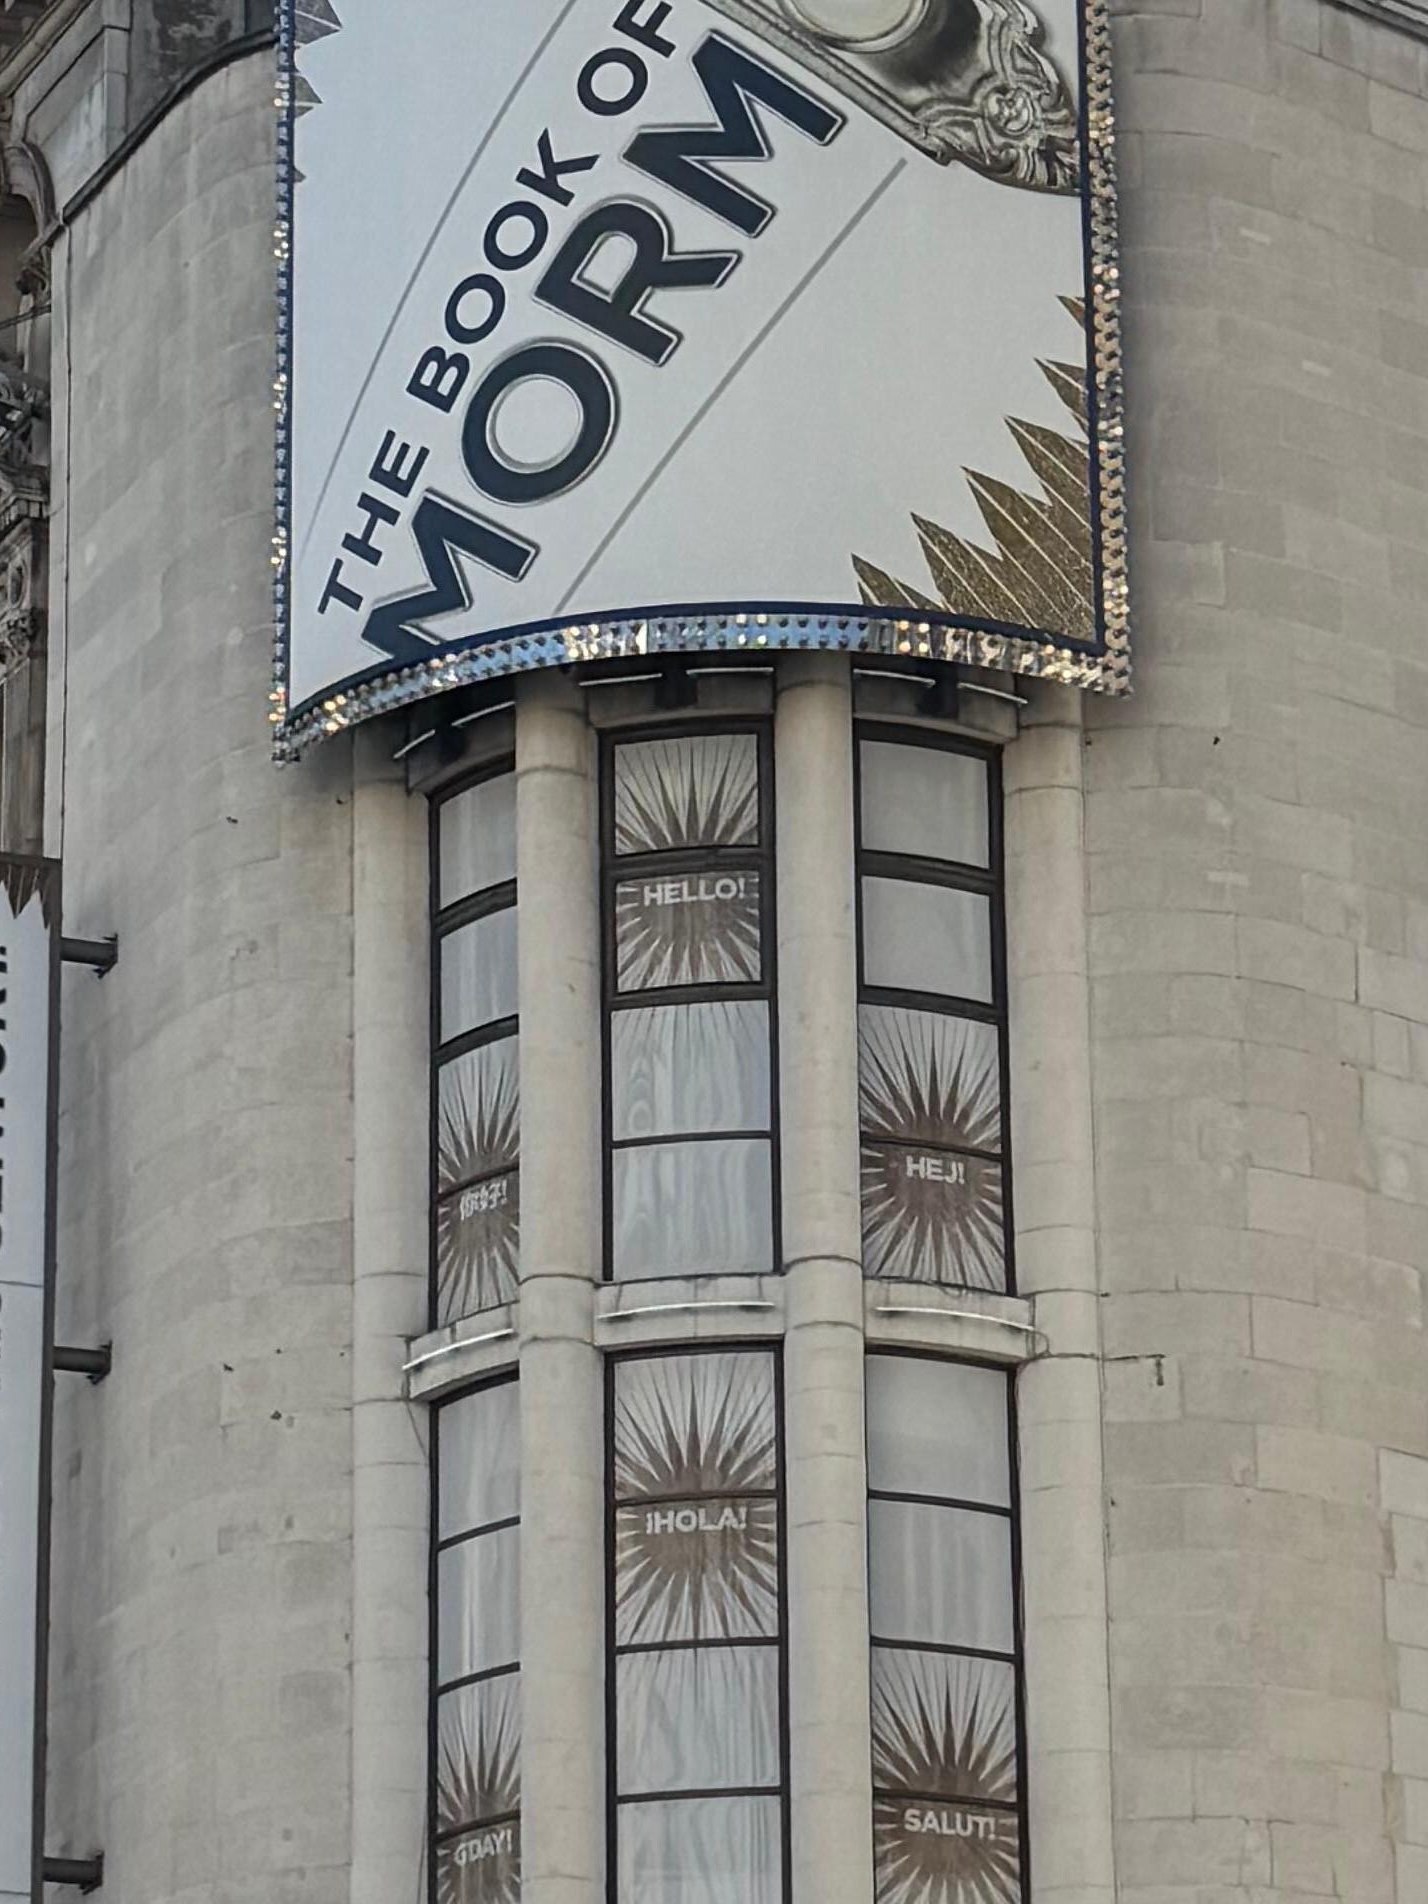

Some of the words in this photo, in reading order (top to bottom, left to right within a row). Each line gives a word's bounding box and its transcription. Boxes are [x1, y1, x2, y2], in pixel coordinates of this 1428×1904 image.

[316, 428, 432, 615] THE
[406, 128, 601, 414] BOOK
[643, 877, 746, 907] HELLO!
[905, 1155, 965, 1184] HEJ!
[903, 1806, 997, 1840] SALUT!
